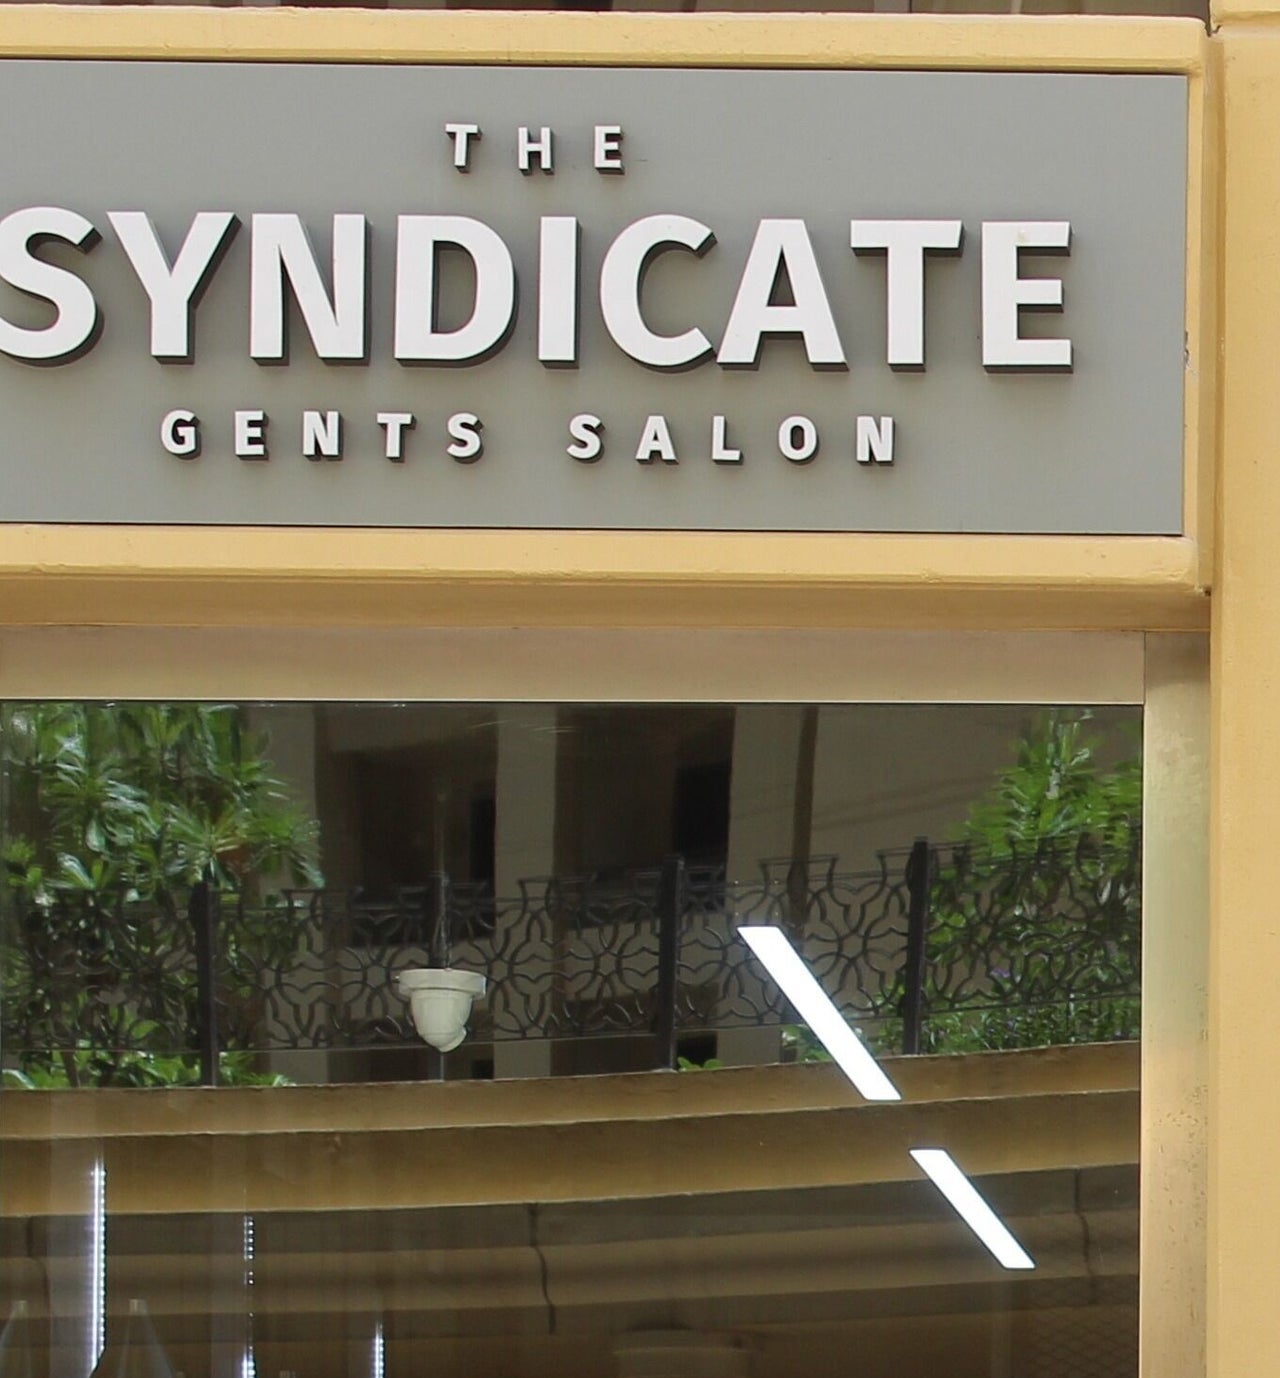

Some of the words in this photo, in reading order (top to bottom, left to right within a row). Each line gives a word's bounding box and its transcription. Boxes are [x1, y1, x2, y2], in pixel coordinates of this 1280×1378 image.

[445, 122, 623, 170] THE
[0, 206, 1072, 367] SYNDICATE
[161, 410, 481, 458] GENTS
[567, 414, 894, 462] SALON
